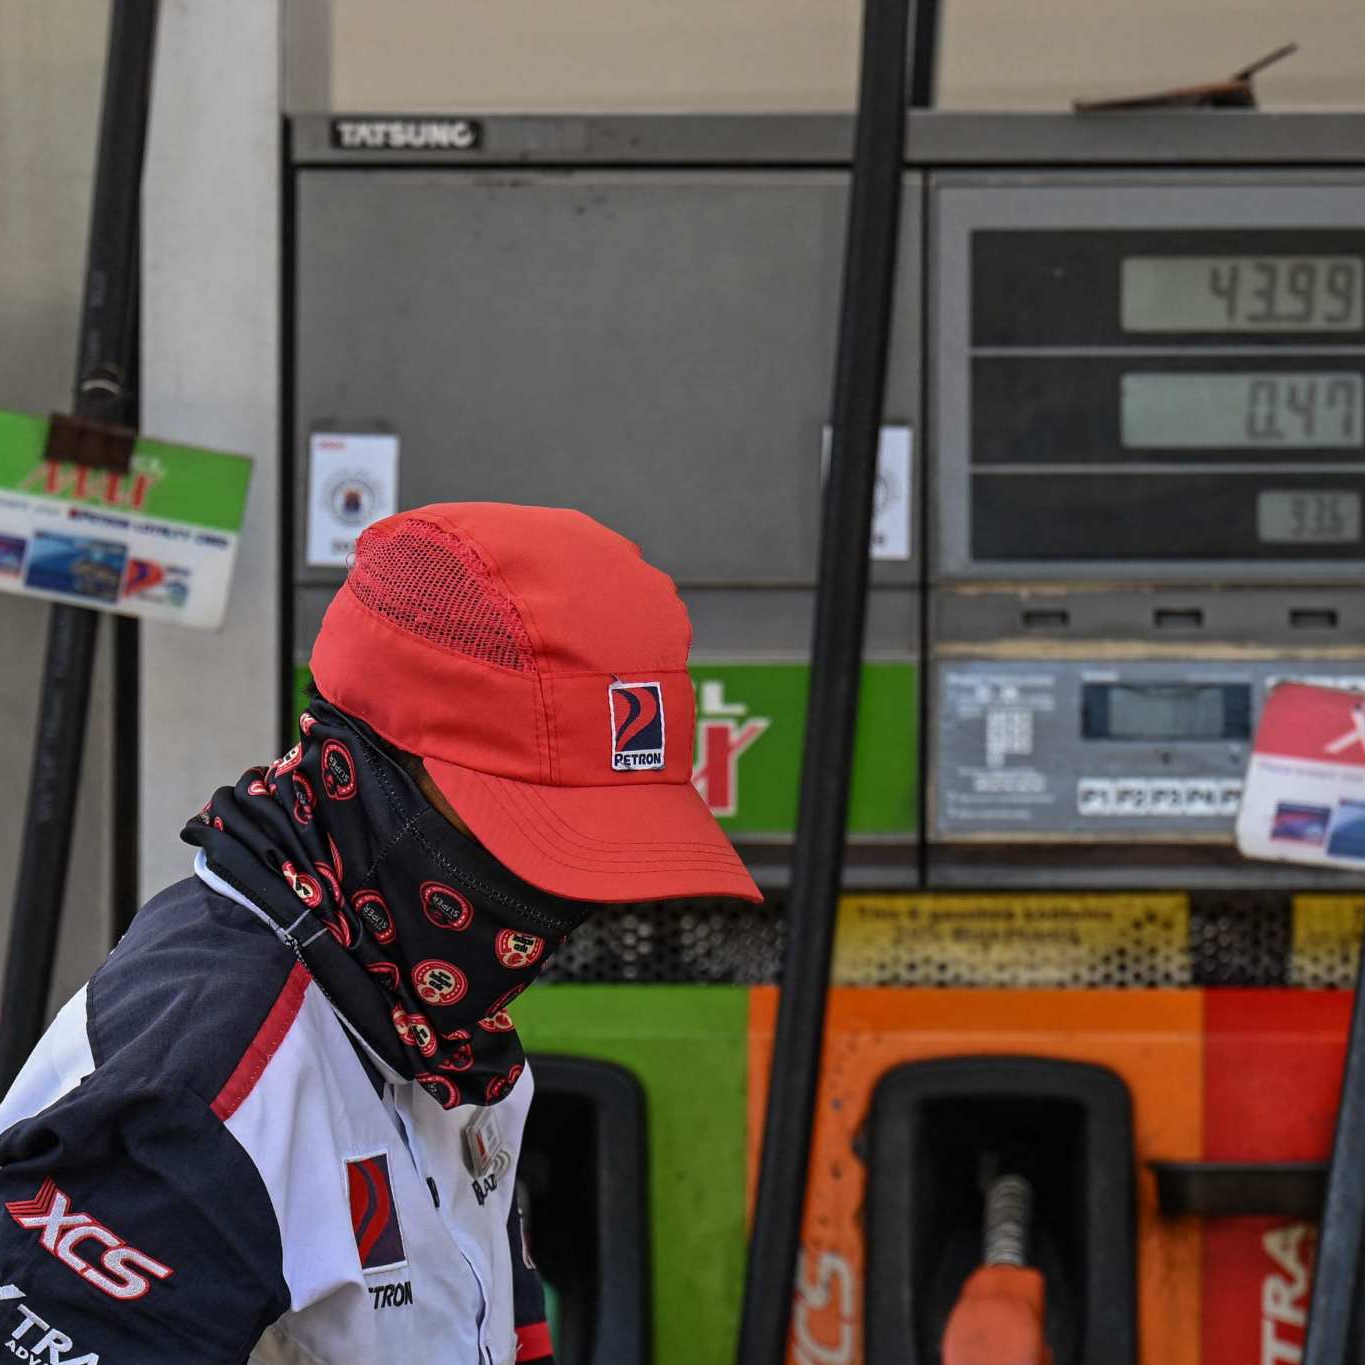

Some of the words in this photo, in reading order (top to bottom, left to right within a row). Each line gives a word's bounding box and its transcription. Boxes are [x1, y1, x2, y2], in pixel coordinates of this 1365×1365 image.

[328, 753, 350, 783] SUPER
[614, 752, 662, 767] PETRON
[362, 902, 388, 930] SUPER
[432, 893, 460, 918] SUPER
[10, 1183, 175, 1300] XCS
